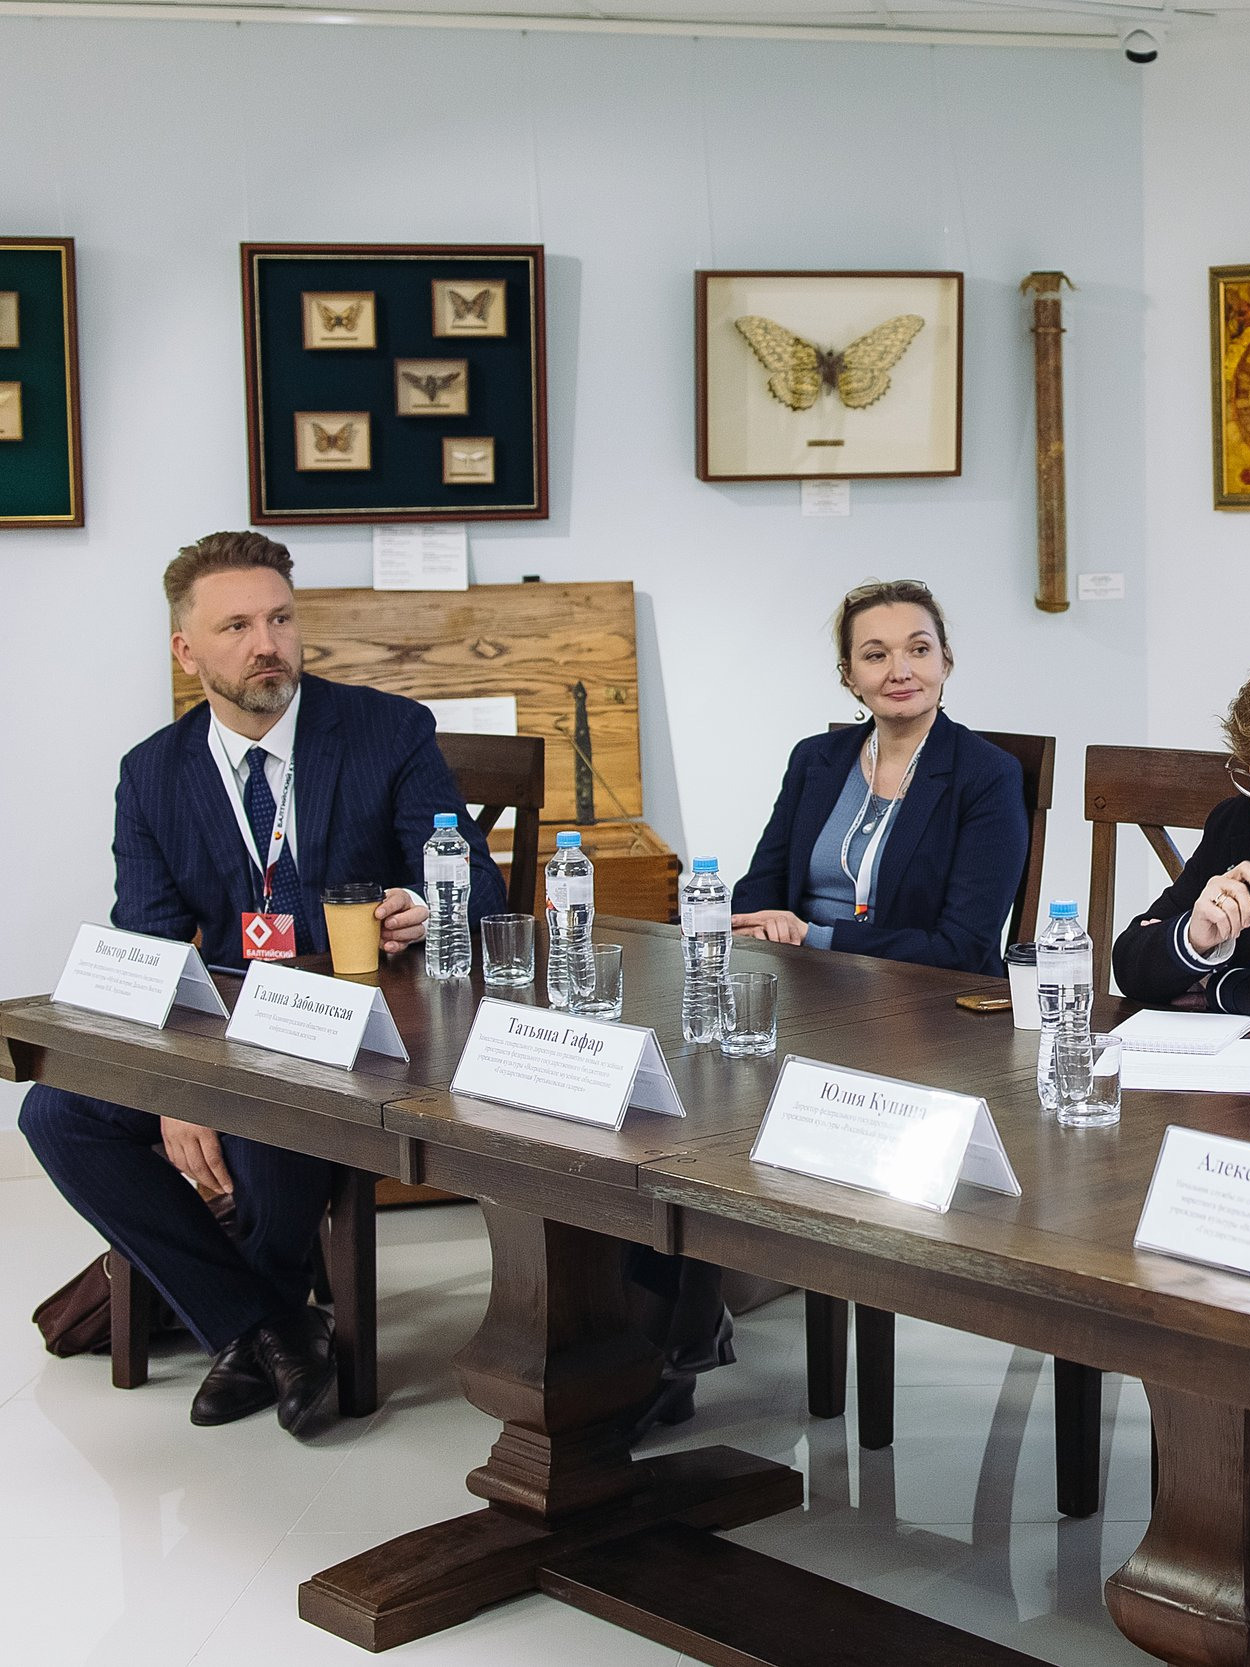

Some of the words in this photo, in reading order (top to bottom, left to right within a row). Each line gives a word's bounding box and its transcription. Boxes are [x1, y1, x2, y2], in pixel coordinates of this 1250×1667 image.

[95, 940, 127, 962] Виктор
[127, 947, 161, 967] Шалай
[246, 948, 295, 959] БАЛТИЙСКИЙ
[253, 984, 290, 1006] Галина
[290, 992, 354, 1021] Заболотская
[508, 1016, 560, 1043] Татьяна
[562, 1028, 604, 1056] Гафар
[819, 1081, 866, 1107] Юлия
